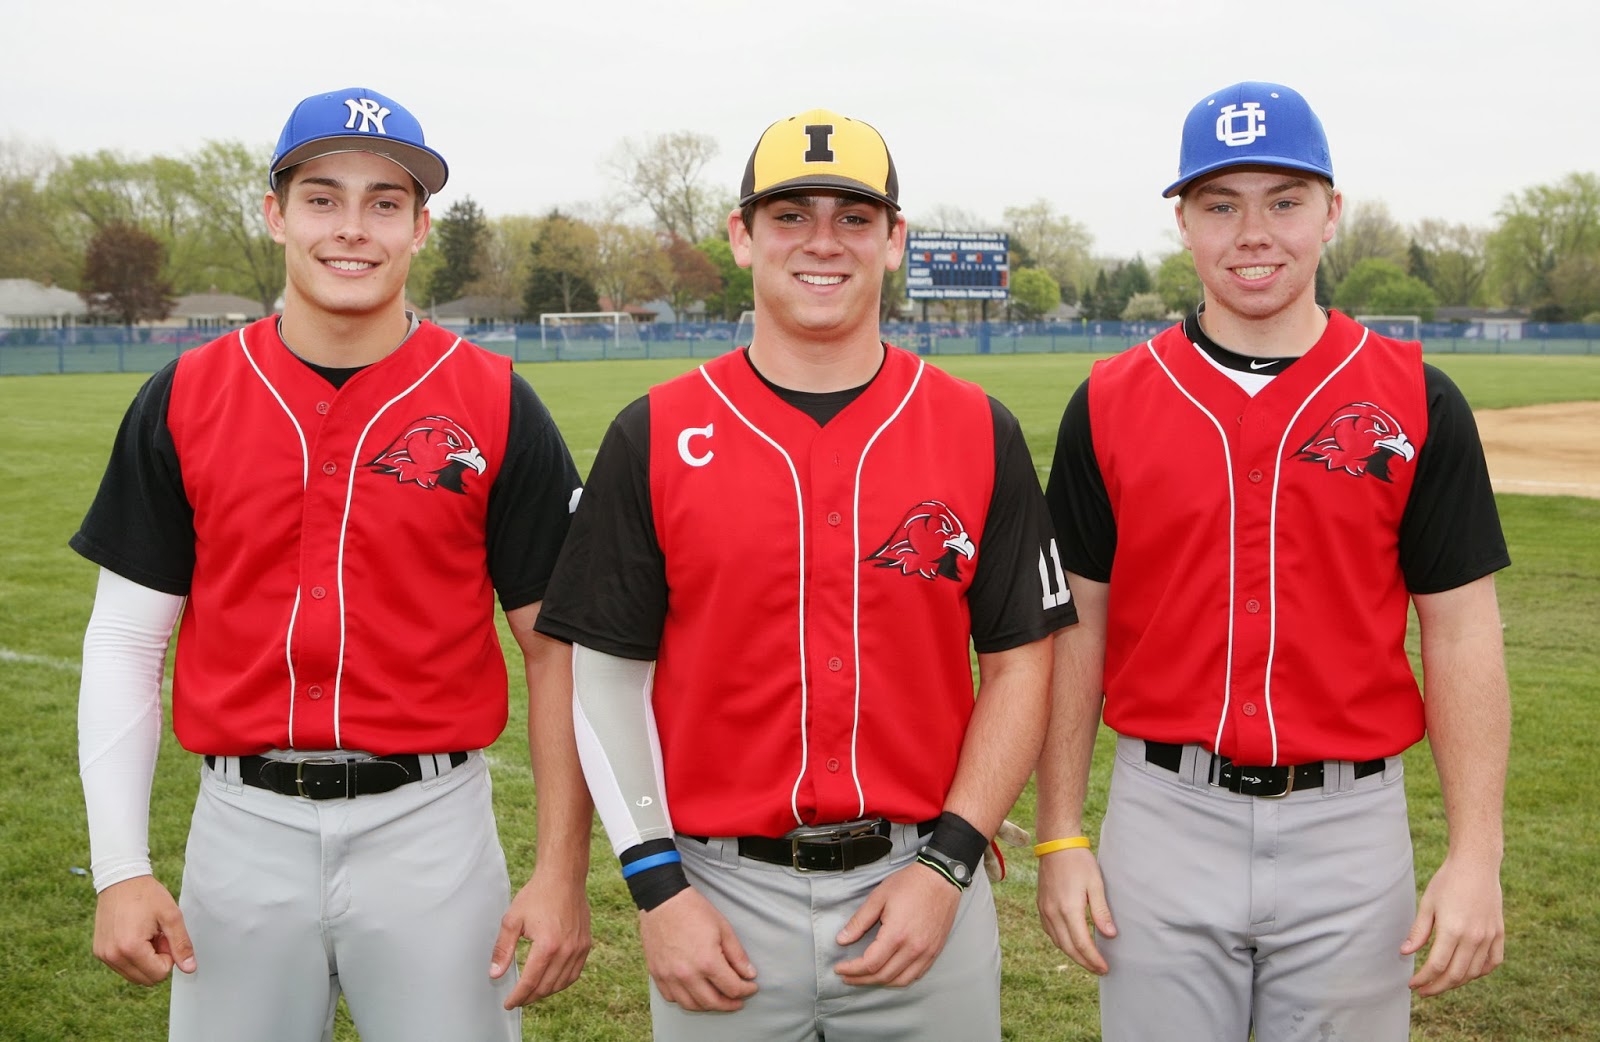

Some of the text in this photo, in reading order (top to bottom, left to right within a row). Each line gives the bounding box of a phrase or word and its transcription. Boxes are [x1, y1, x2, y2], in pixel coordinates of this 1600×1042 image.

[803, 124, 835, 163] I
[910, 241, 1006, 251] PROSPECT BASEBALL
[677, 422, 715, 467] C
[1038, 538, 1071, 610] 11
